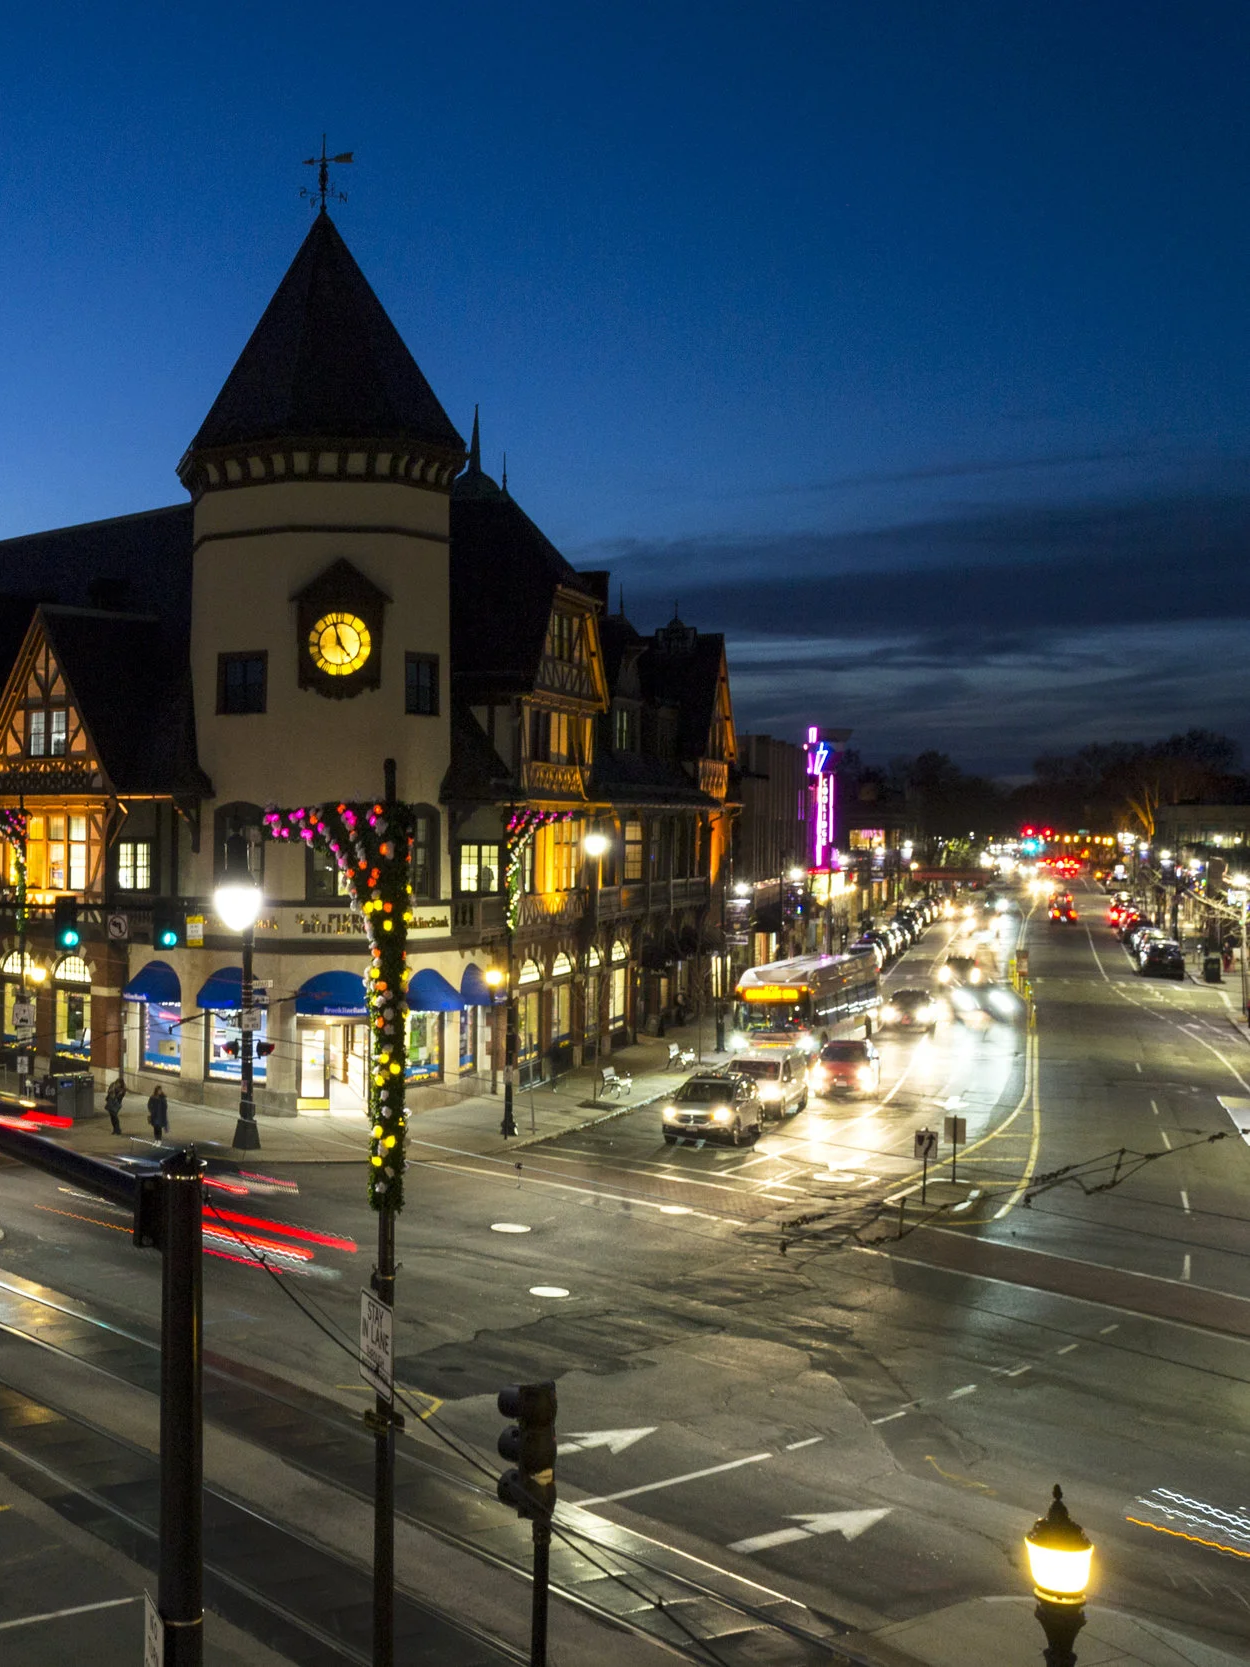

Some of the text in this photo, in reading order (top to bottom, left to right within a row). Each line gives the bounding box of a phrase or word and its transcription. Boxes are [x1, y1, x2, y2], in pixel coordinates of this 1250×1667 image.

[328, 913, 365, 925] PIER
[323, 1006, 368, 1015] BrooklineBank
[367, 1301, 384, 1325] STAY
[362, 1316, 390, 1356] IN LANE
